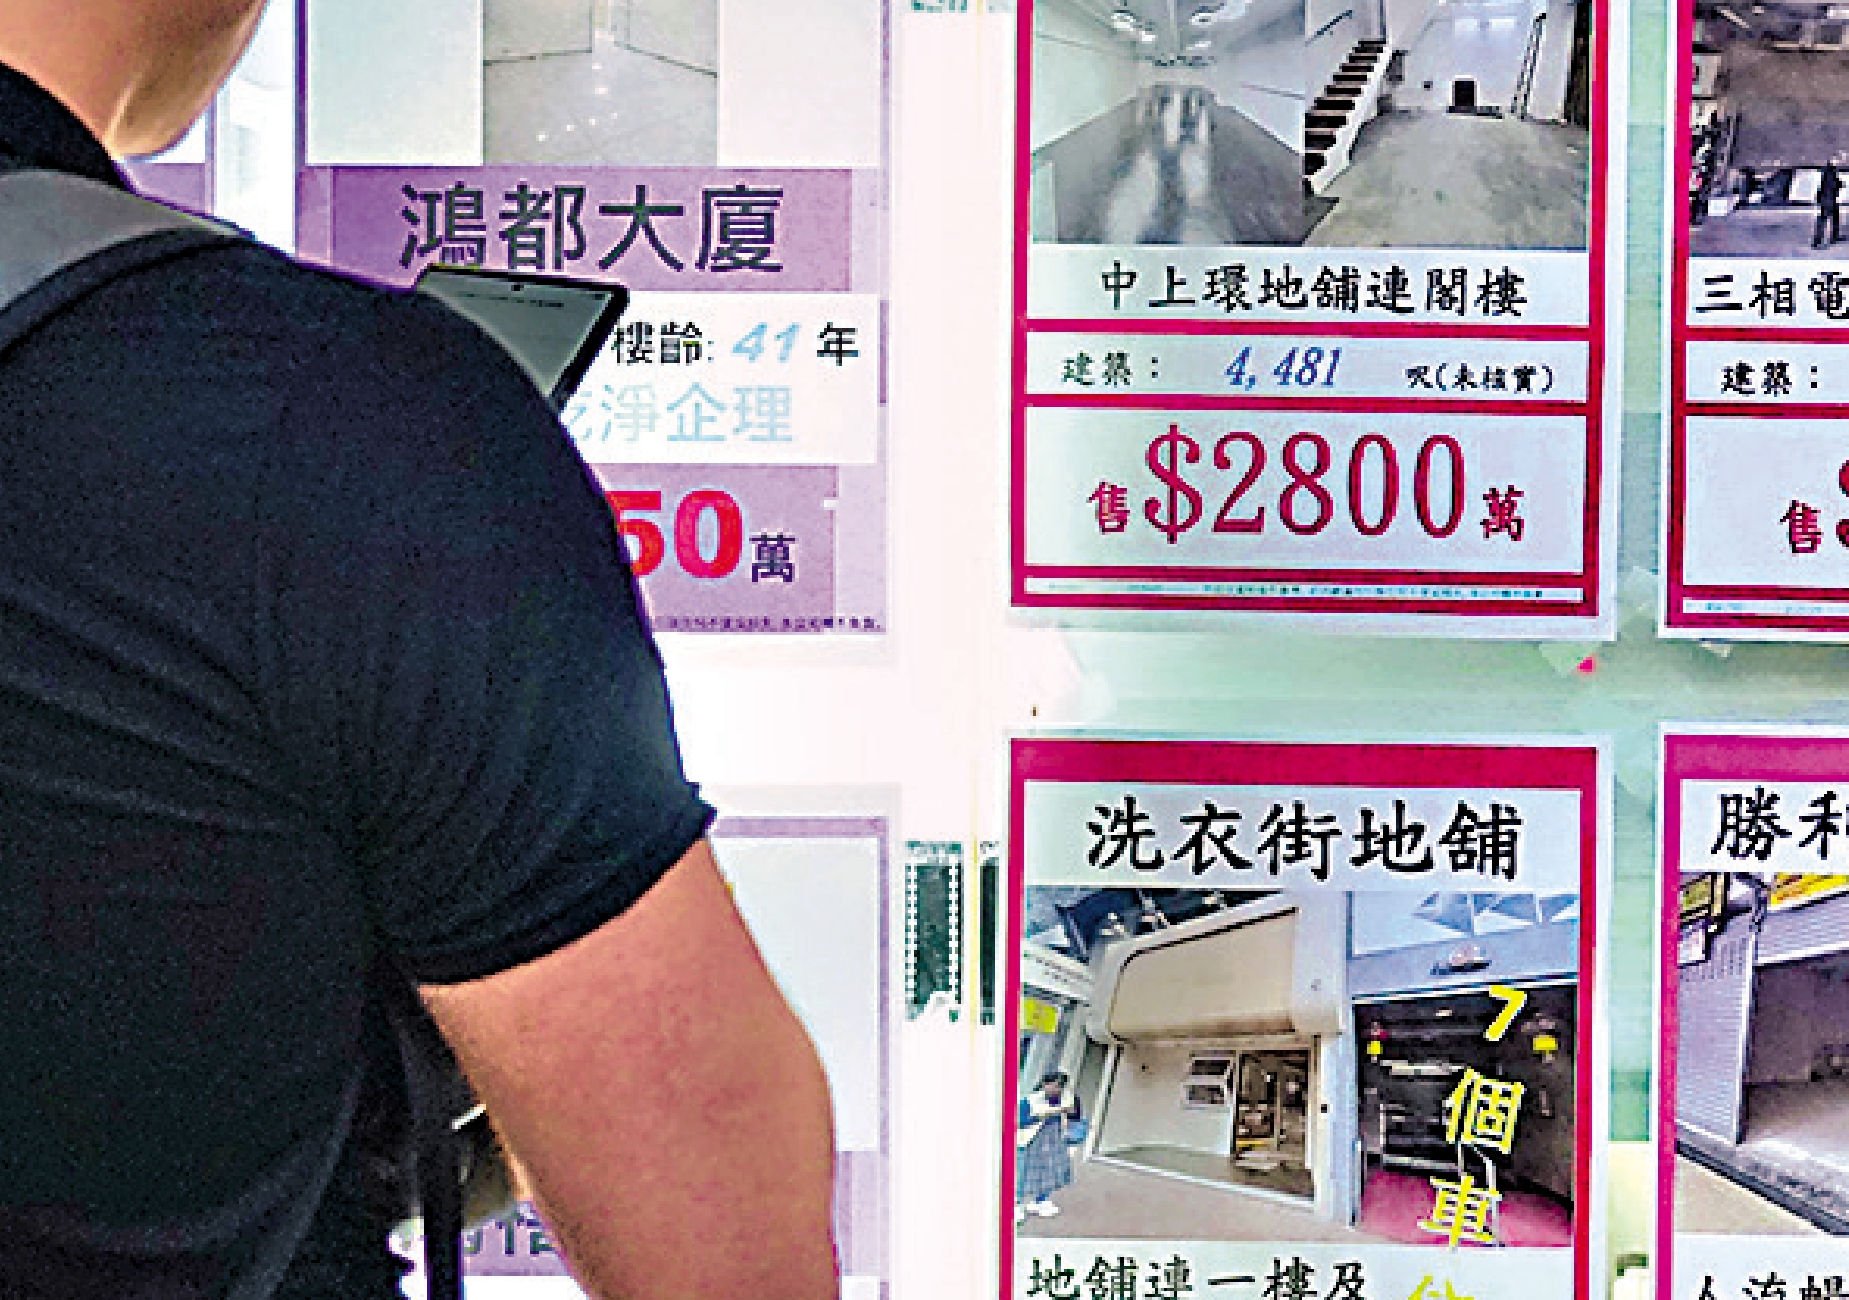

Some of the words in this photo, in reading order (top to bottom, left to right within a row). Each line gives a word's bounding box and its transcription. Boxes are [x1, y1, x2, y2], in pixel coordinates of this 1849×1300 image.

[399, 183, 784, 273] 鴻都大廈
[732, 322, 801, 364] 41
[816, 322, 860, 367] 年
[1224, 347, 1344, 390] 4,481
[1086, 796, 1524, 881] 洗衣街地舖
